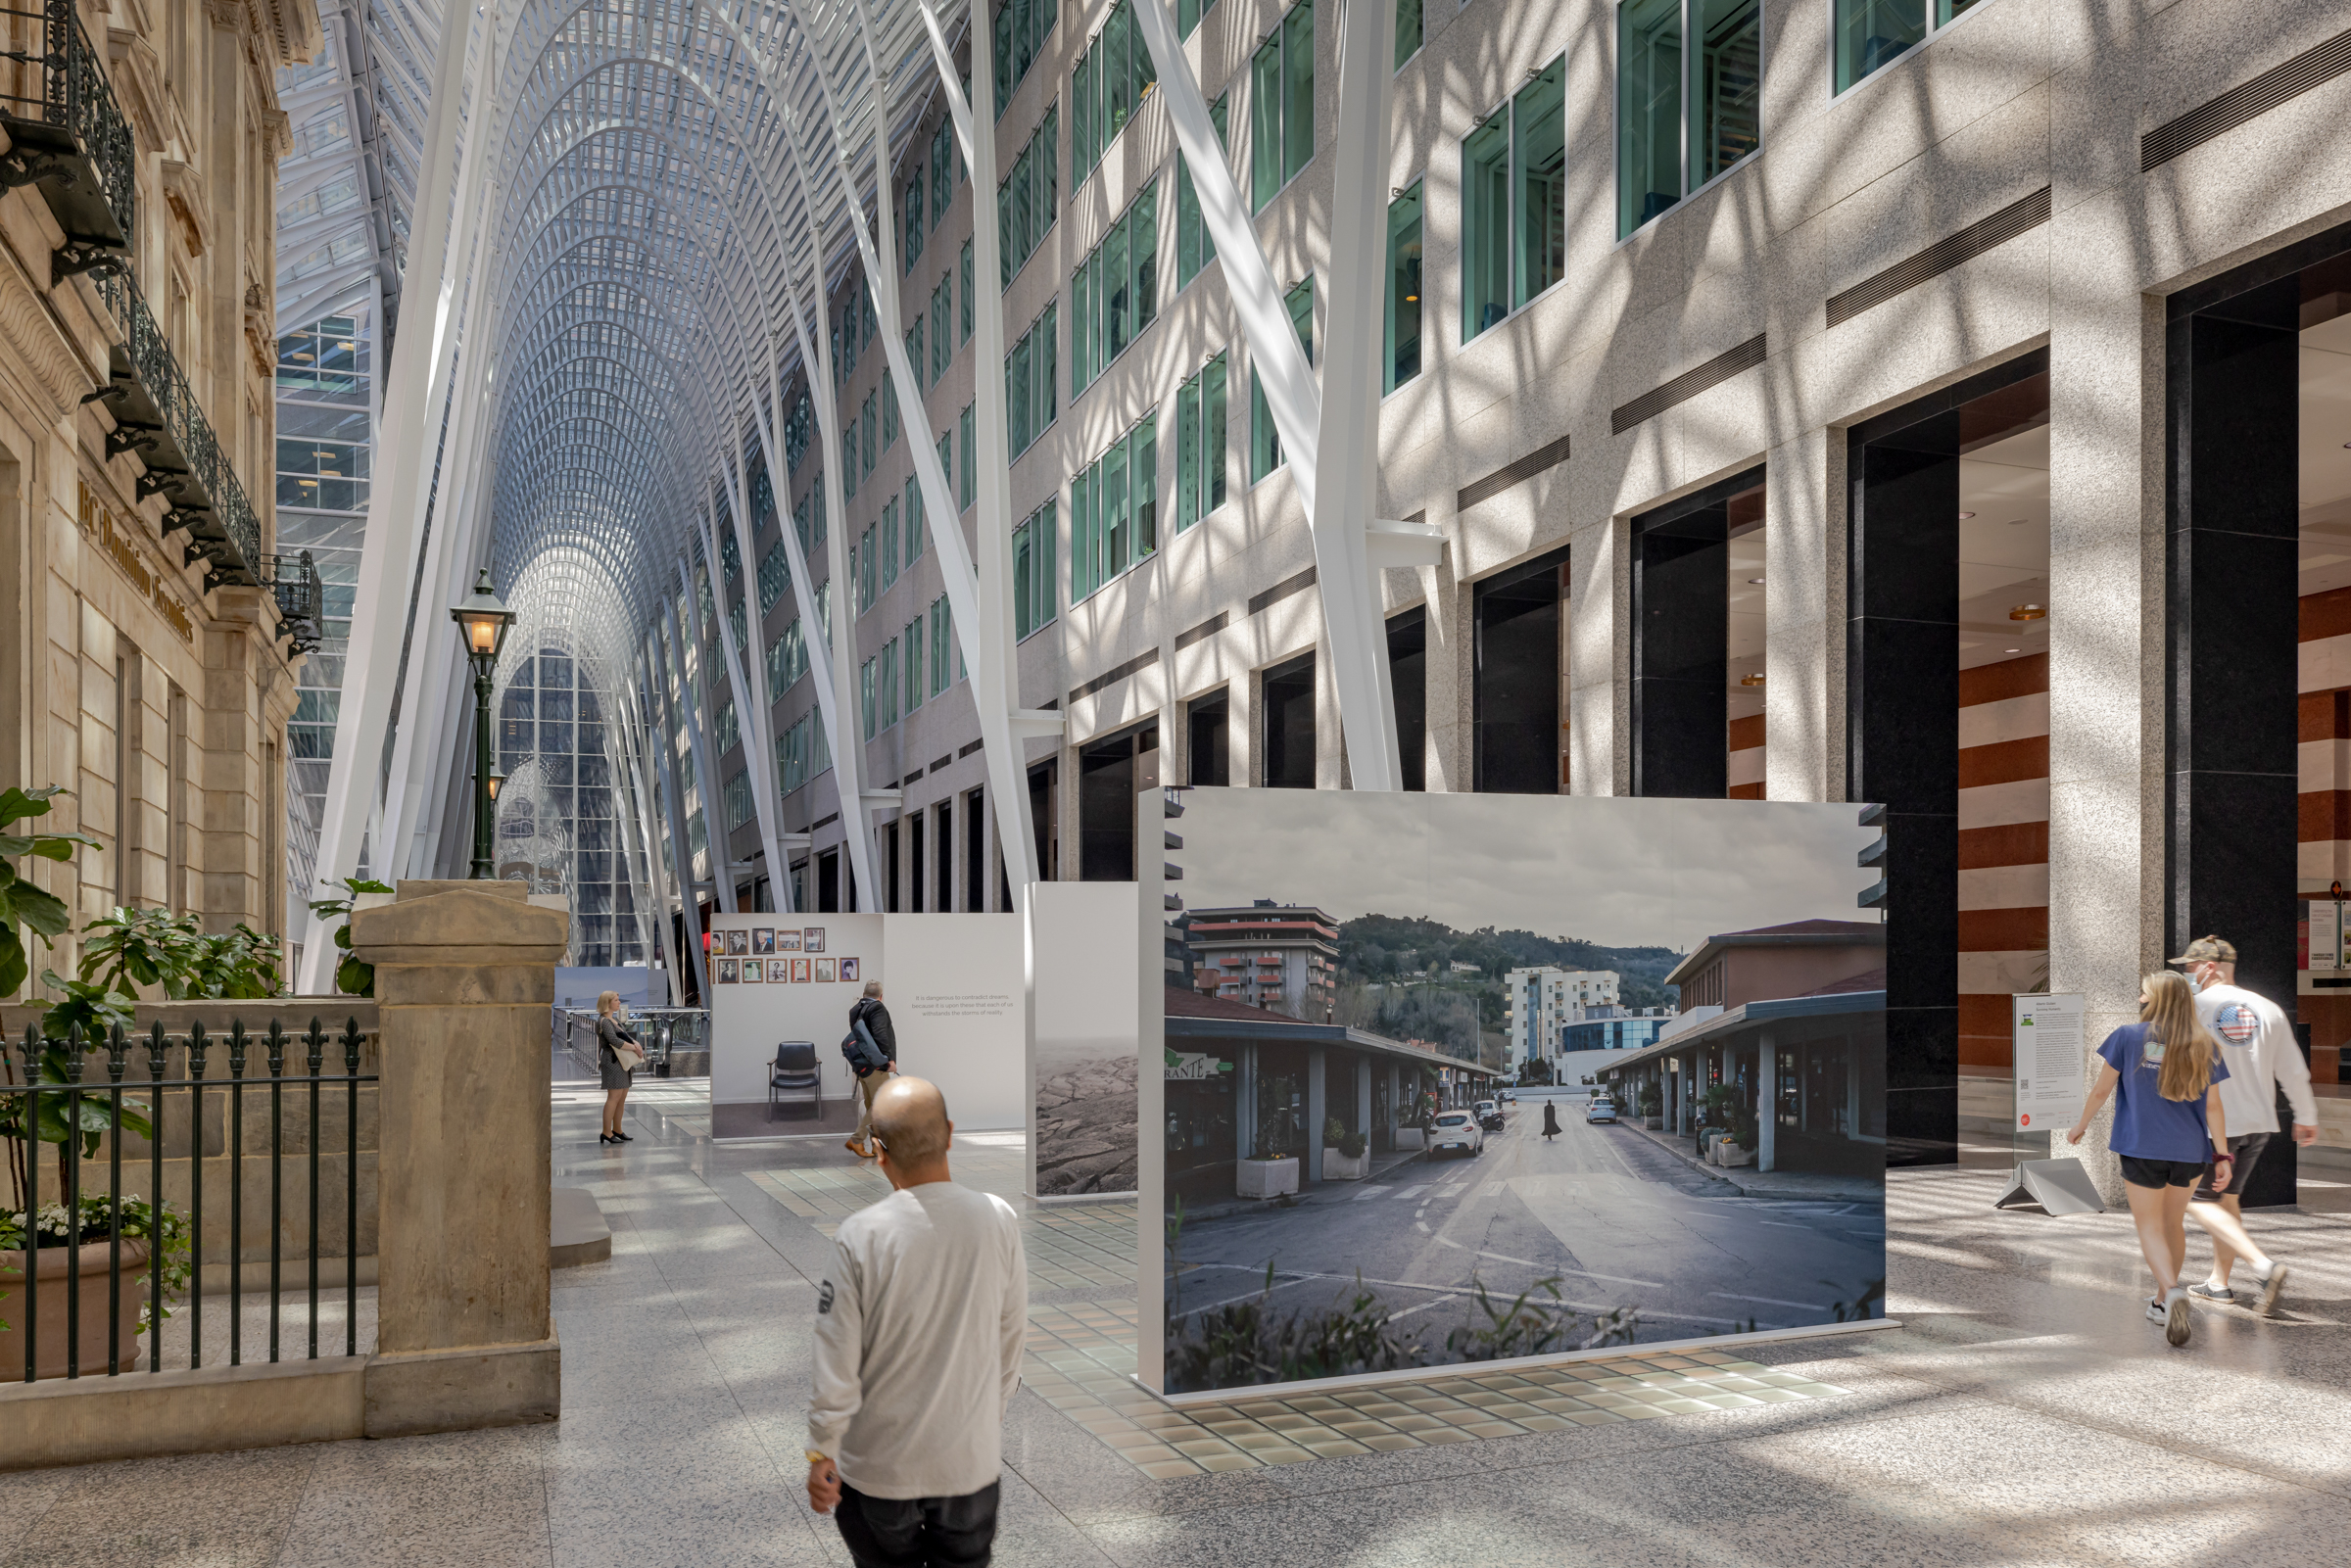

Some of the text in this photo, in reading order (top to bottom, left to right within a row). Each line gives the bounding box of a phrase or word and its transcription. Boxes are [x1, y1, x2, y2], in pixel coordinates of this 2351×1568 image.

[101, 508, 150, 597] Dominion
[154, 575, 193, 644] Securities
[1165, 1057, 1204, 1078] RANTE
